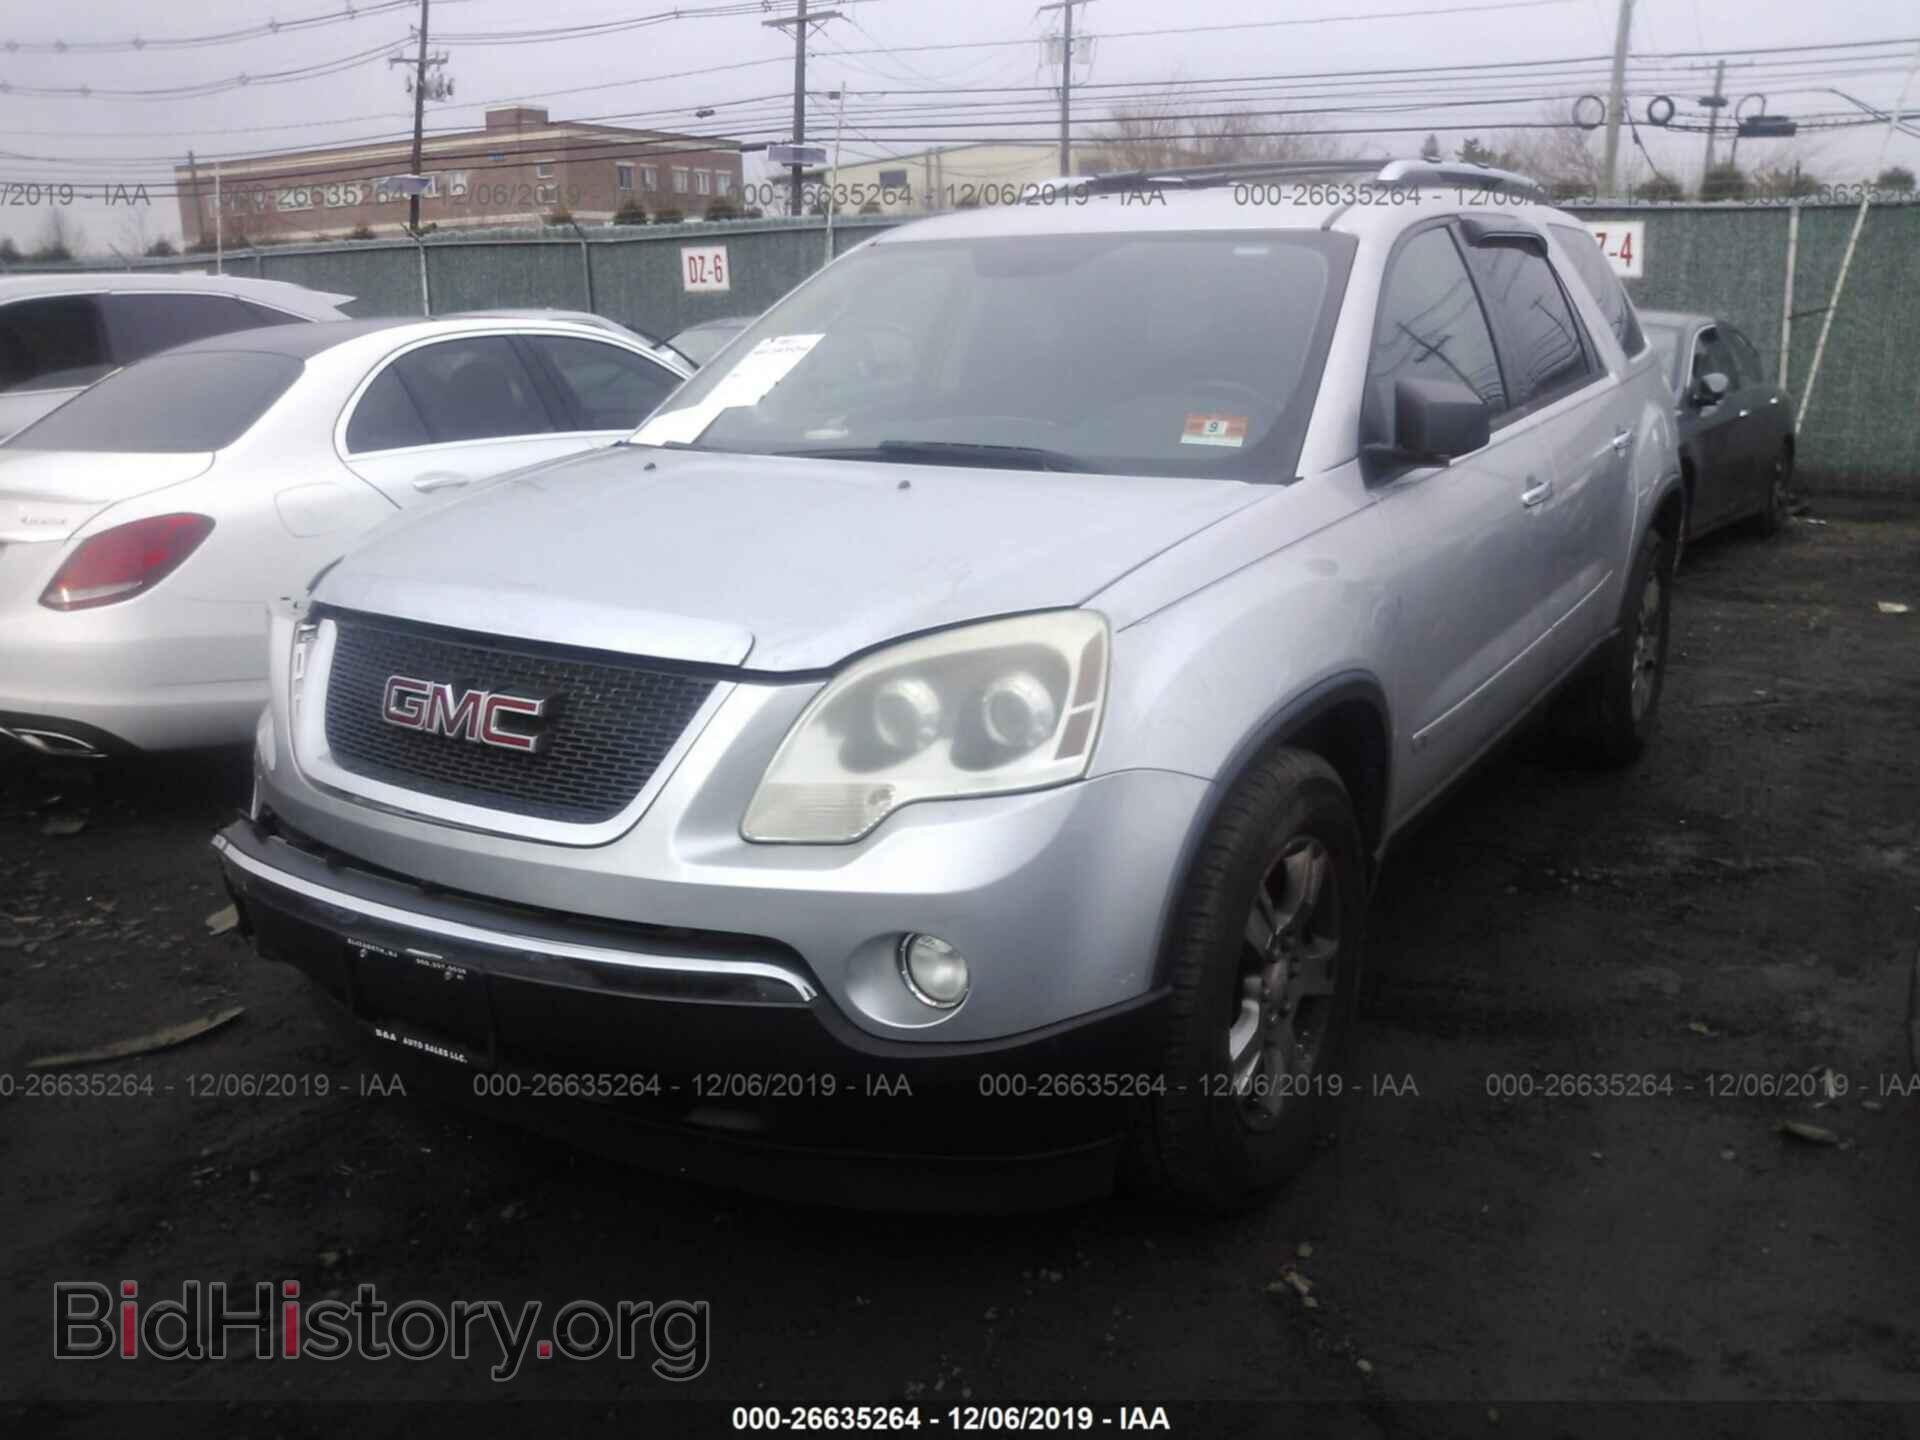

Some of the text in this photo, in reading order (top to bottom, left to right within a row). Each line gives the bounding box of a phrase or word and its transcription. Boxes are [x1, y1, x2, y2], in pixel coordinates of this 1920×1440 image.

[688, 254, 723, 284] DZ-6
[1207, 421, 1217, 433] 9
[383, 675, 544, 753] GMC
[403, 1037, 423, 1050] AUTO
[425, 1043, 449, 1058] SALES
